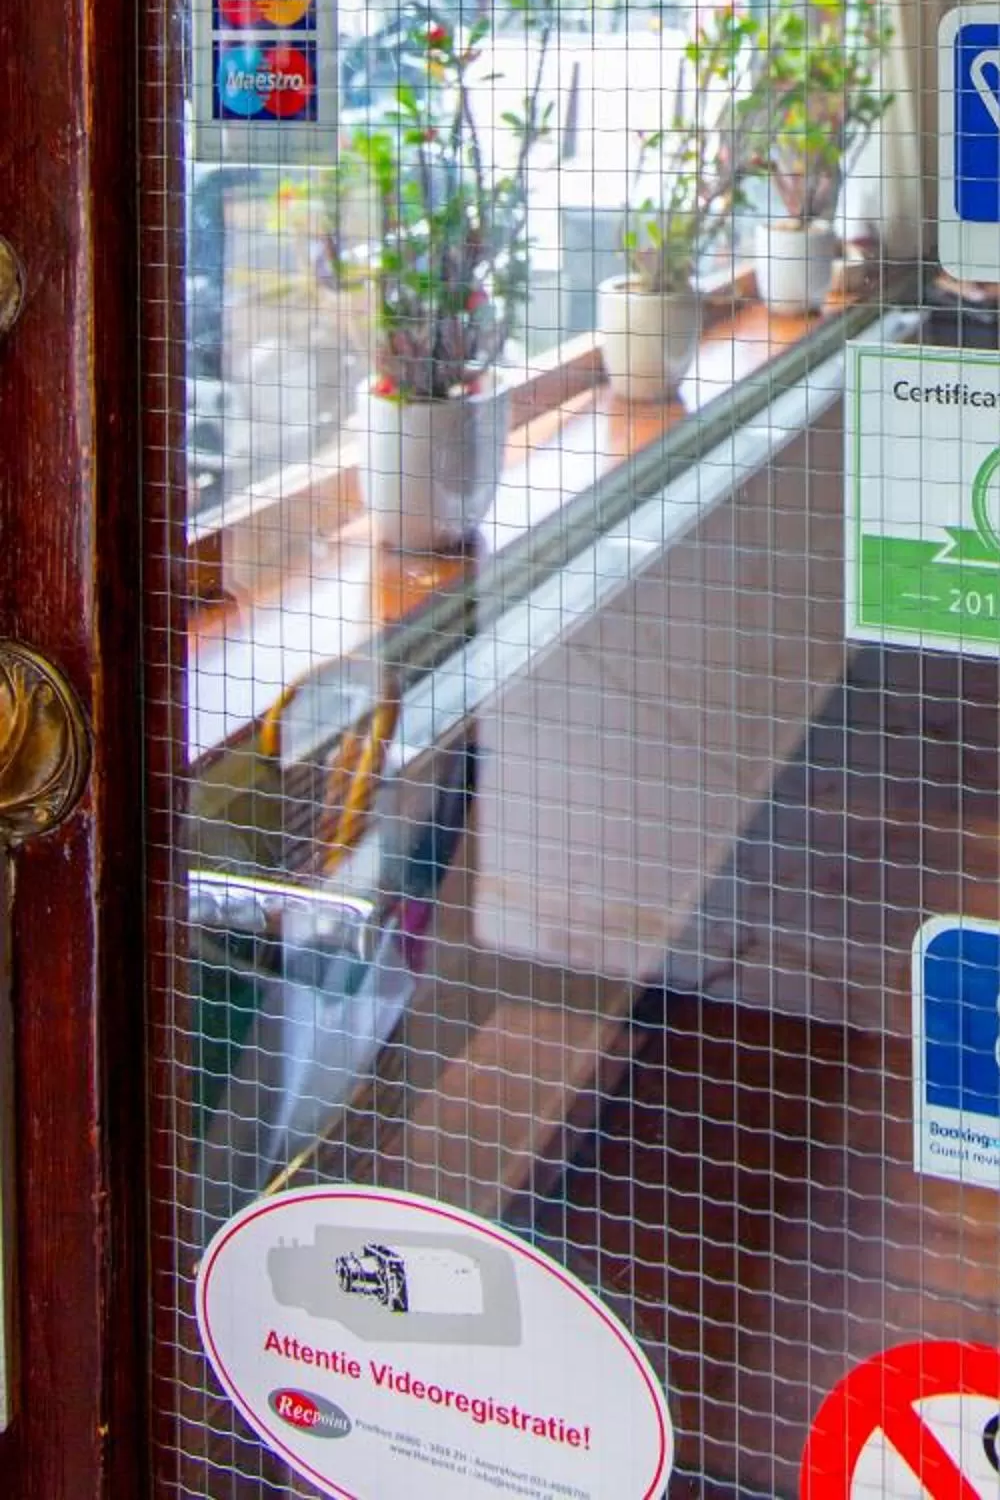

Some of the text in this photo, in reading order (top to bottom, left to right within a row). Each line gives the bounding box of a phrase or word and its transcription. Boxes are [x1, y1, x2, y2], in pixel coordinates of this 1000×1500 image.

[226, 70, 304, 91] Maestro
[263, 1329, 362, 1380] Attentie
[368, 1359, 592, 1451] Videoregistratie!
[277, 1394, 349, 1433] Recpoint
